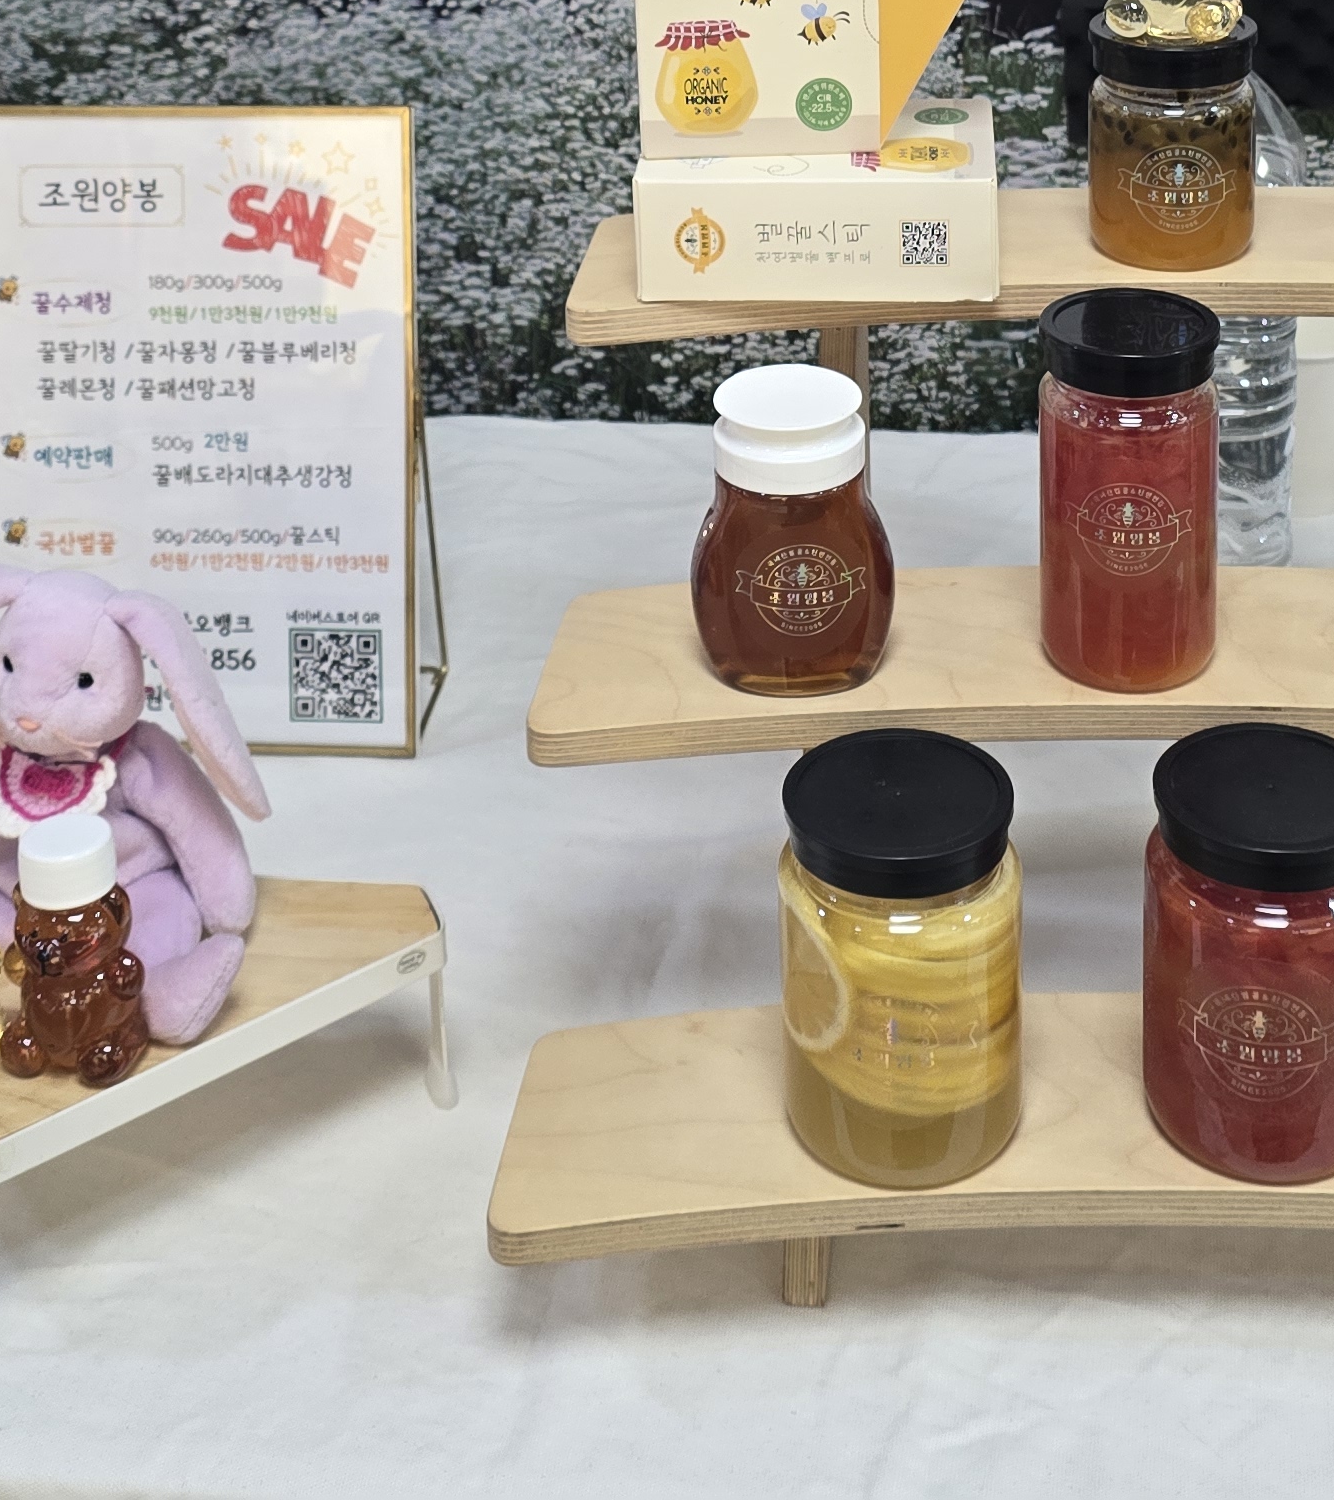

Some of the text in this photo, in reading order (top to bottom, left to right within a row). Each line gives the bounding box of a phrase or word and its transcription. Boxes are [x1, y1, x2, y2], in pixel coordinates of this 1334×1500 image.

[683, 77, 728, 95] ORGANIC
[685, 94, 729, 105] HONEY
[38, 177, 164, 214] 조원양봉
[222, 184, 376, 289] SALE
[754, 220, 871, 245] 벌꿀스틱
[147, 275, 283, 293] 180g/300g/500g
[31, 291, 112, 316] 꿀수제청
[35, 340, 116, 365] 꿀딸기청
[35, 377, 116, 401] 꿀레몬청
[151, 431, 250, 454] 500g 2만원
[32, 445, 115, 469] 예약판매
[151, 463, 353, 489] 꿀배도라지대추생강청
[35, 530, 117, 557] 국산벌꿀
[152, 526, 341, 547] 90g/260g/500g/꿀스틱
[361, 611, 382, 625] QR
[202, 647, 256, 671] 856
